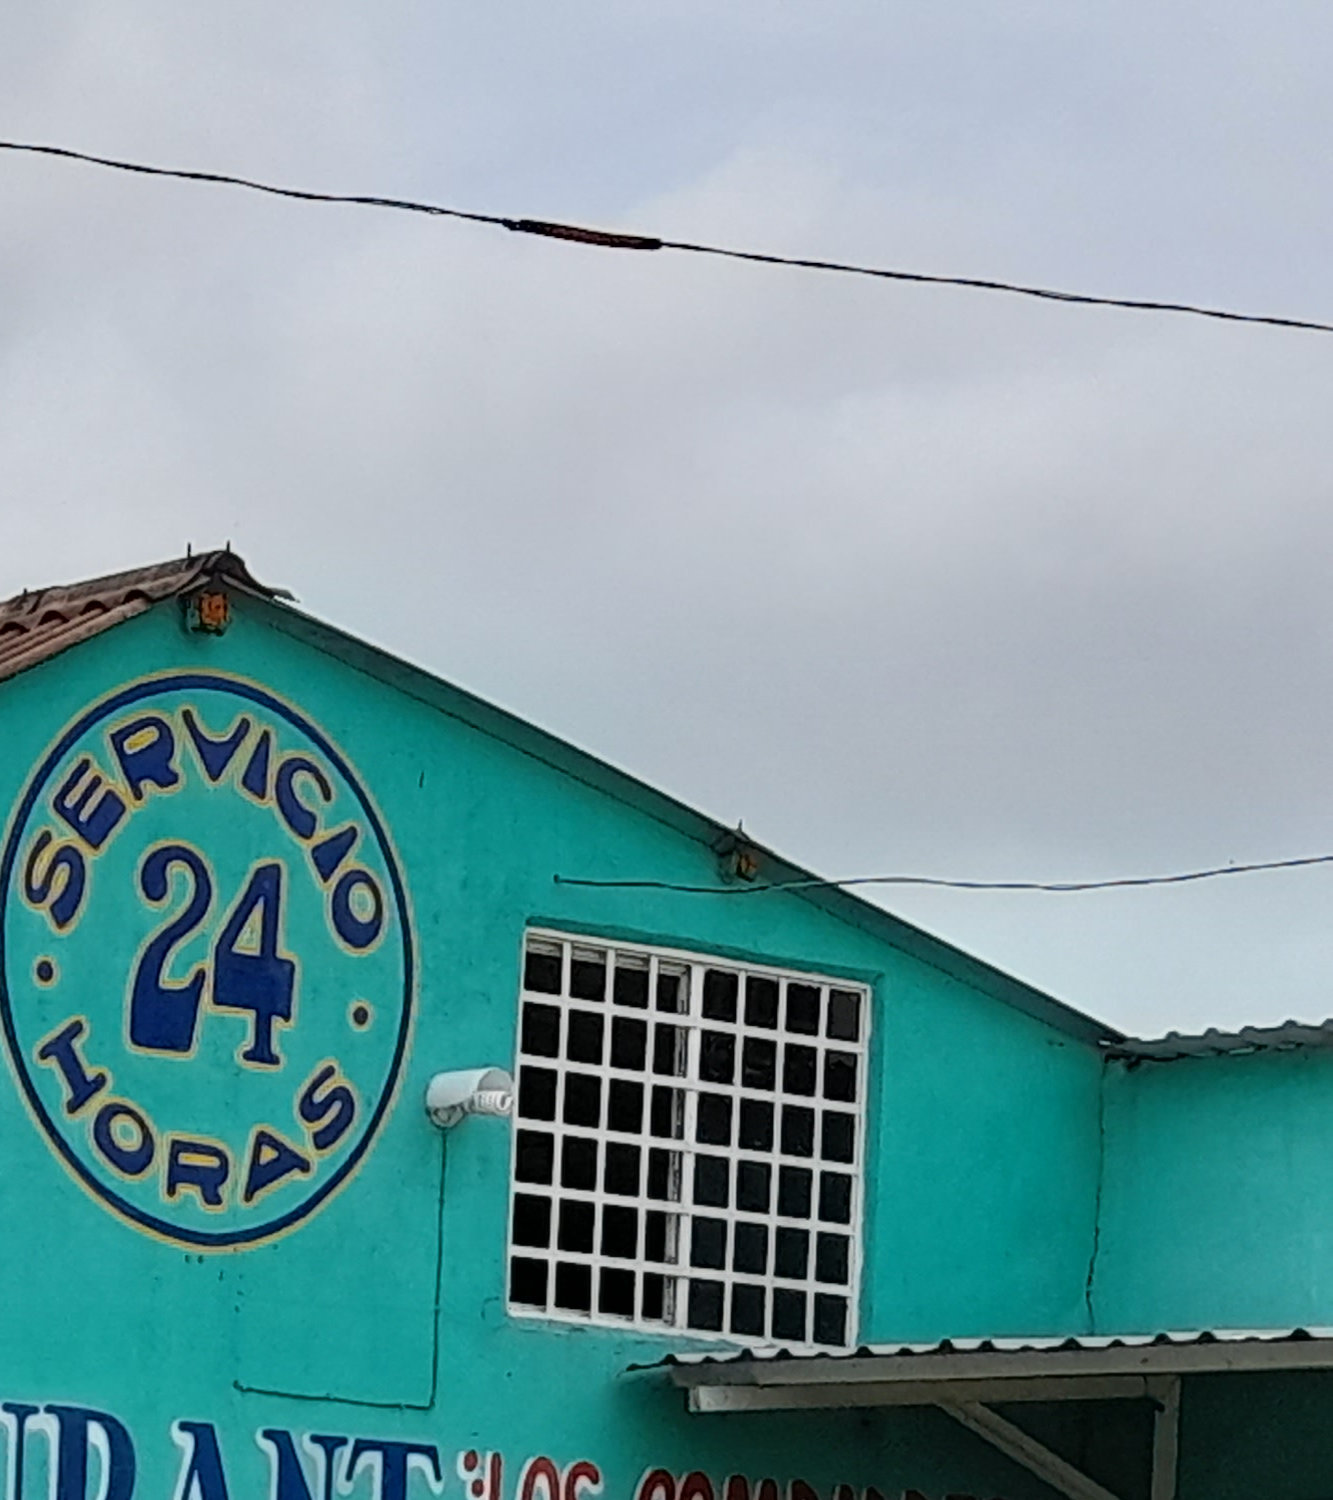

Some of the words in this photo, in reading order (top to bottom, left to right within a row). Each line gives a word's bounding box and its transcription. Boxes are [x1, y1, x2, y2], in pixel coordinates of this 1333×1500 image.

[21, 704, 387, 952] SERVICIO
[130, 842, 298, 1068] 24
[35, 1018, 359, 1208] HORAS
